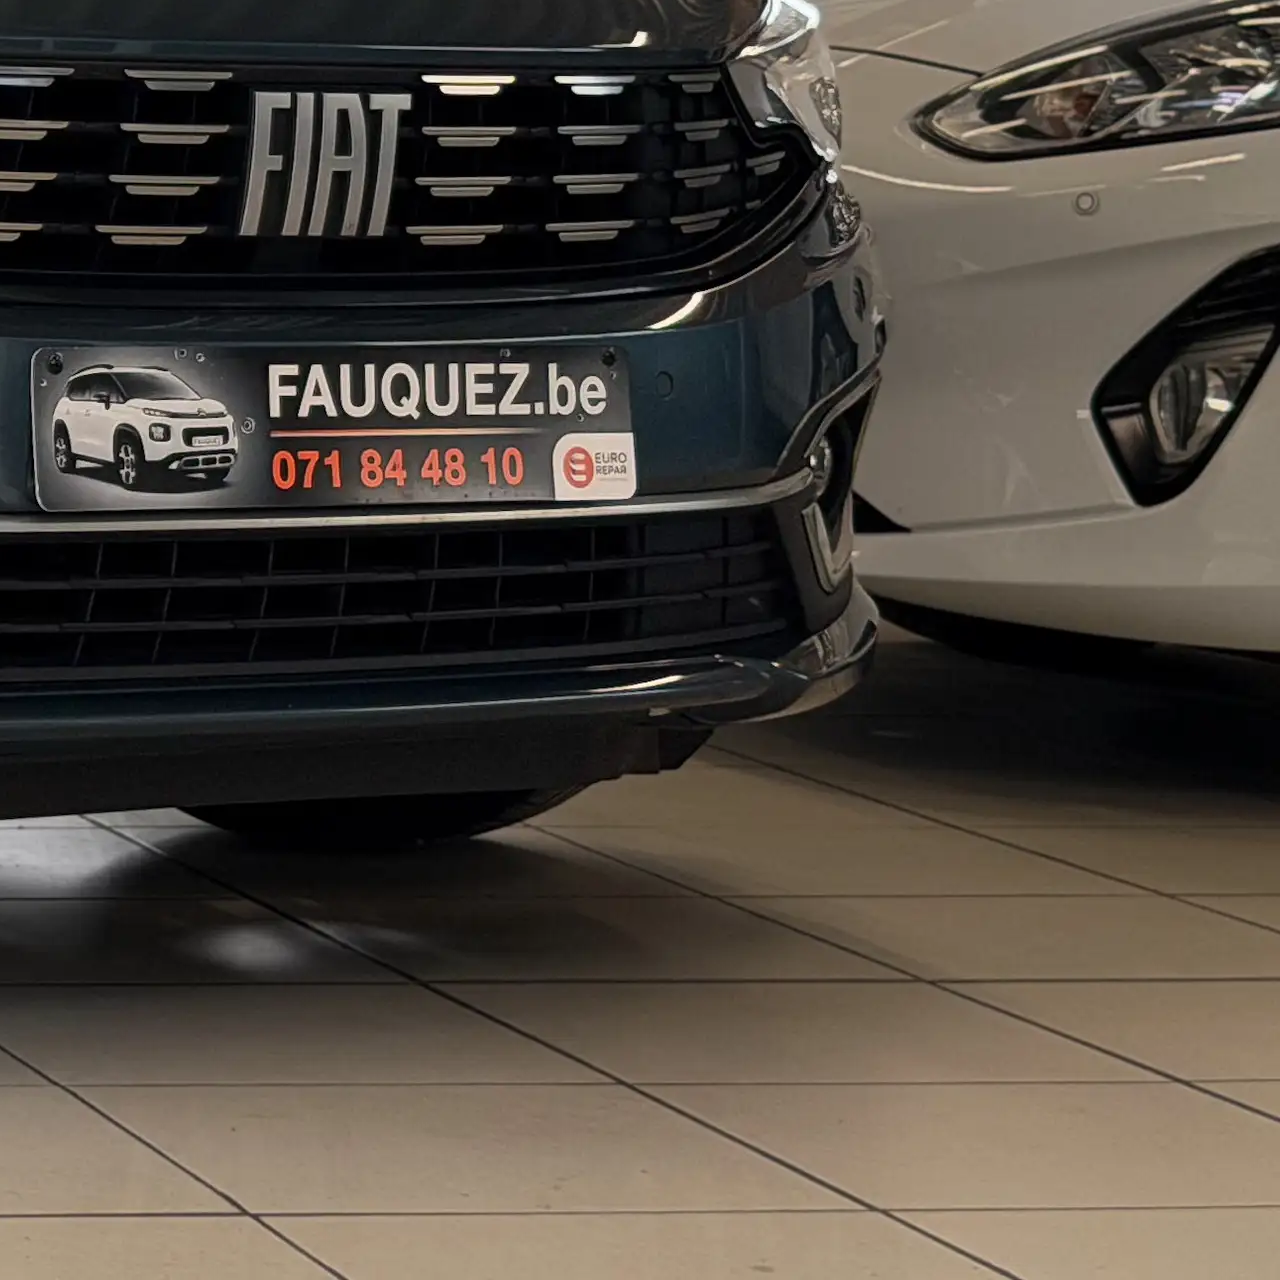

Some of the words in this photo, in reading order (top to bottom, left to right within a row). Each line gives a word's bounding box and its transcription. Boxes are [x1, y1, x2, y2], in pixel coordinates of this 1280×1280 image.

[238, 91, 413, 238] FIAT
[268, 363, 607, 420] FAUQUEZ.be
[272, 450, 342, 490] 071
[360, 448, 408, 488] 84
[421, 447, 467, 487] 48
[480, 446, 525, 486] 10
[594, 452, 628, 464] EURO
